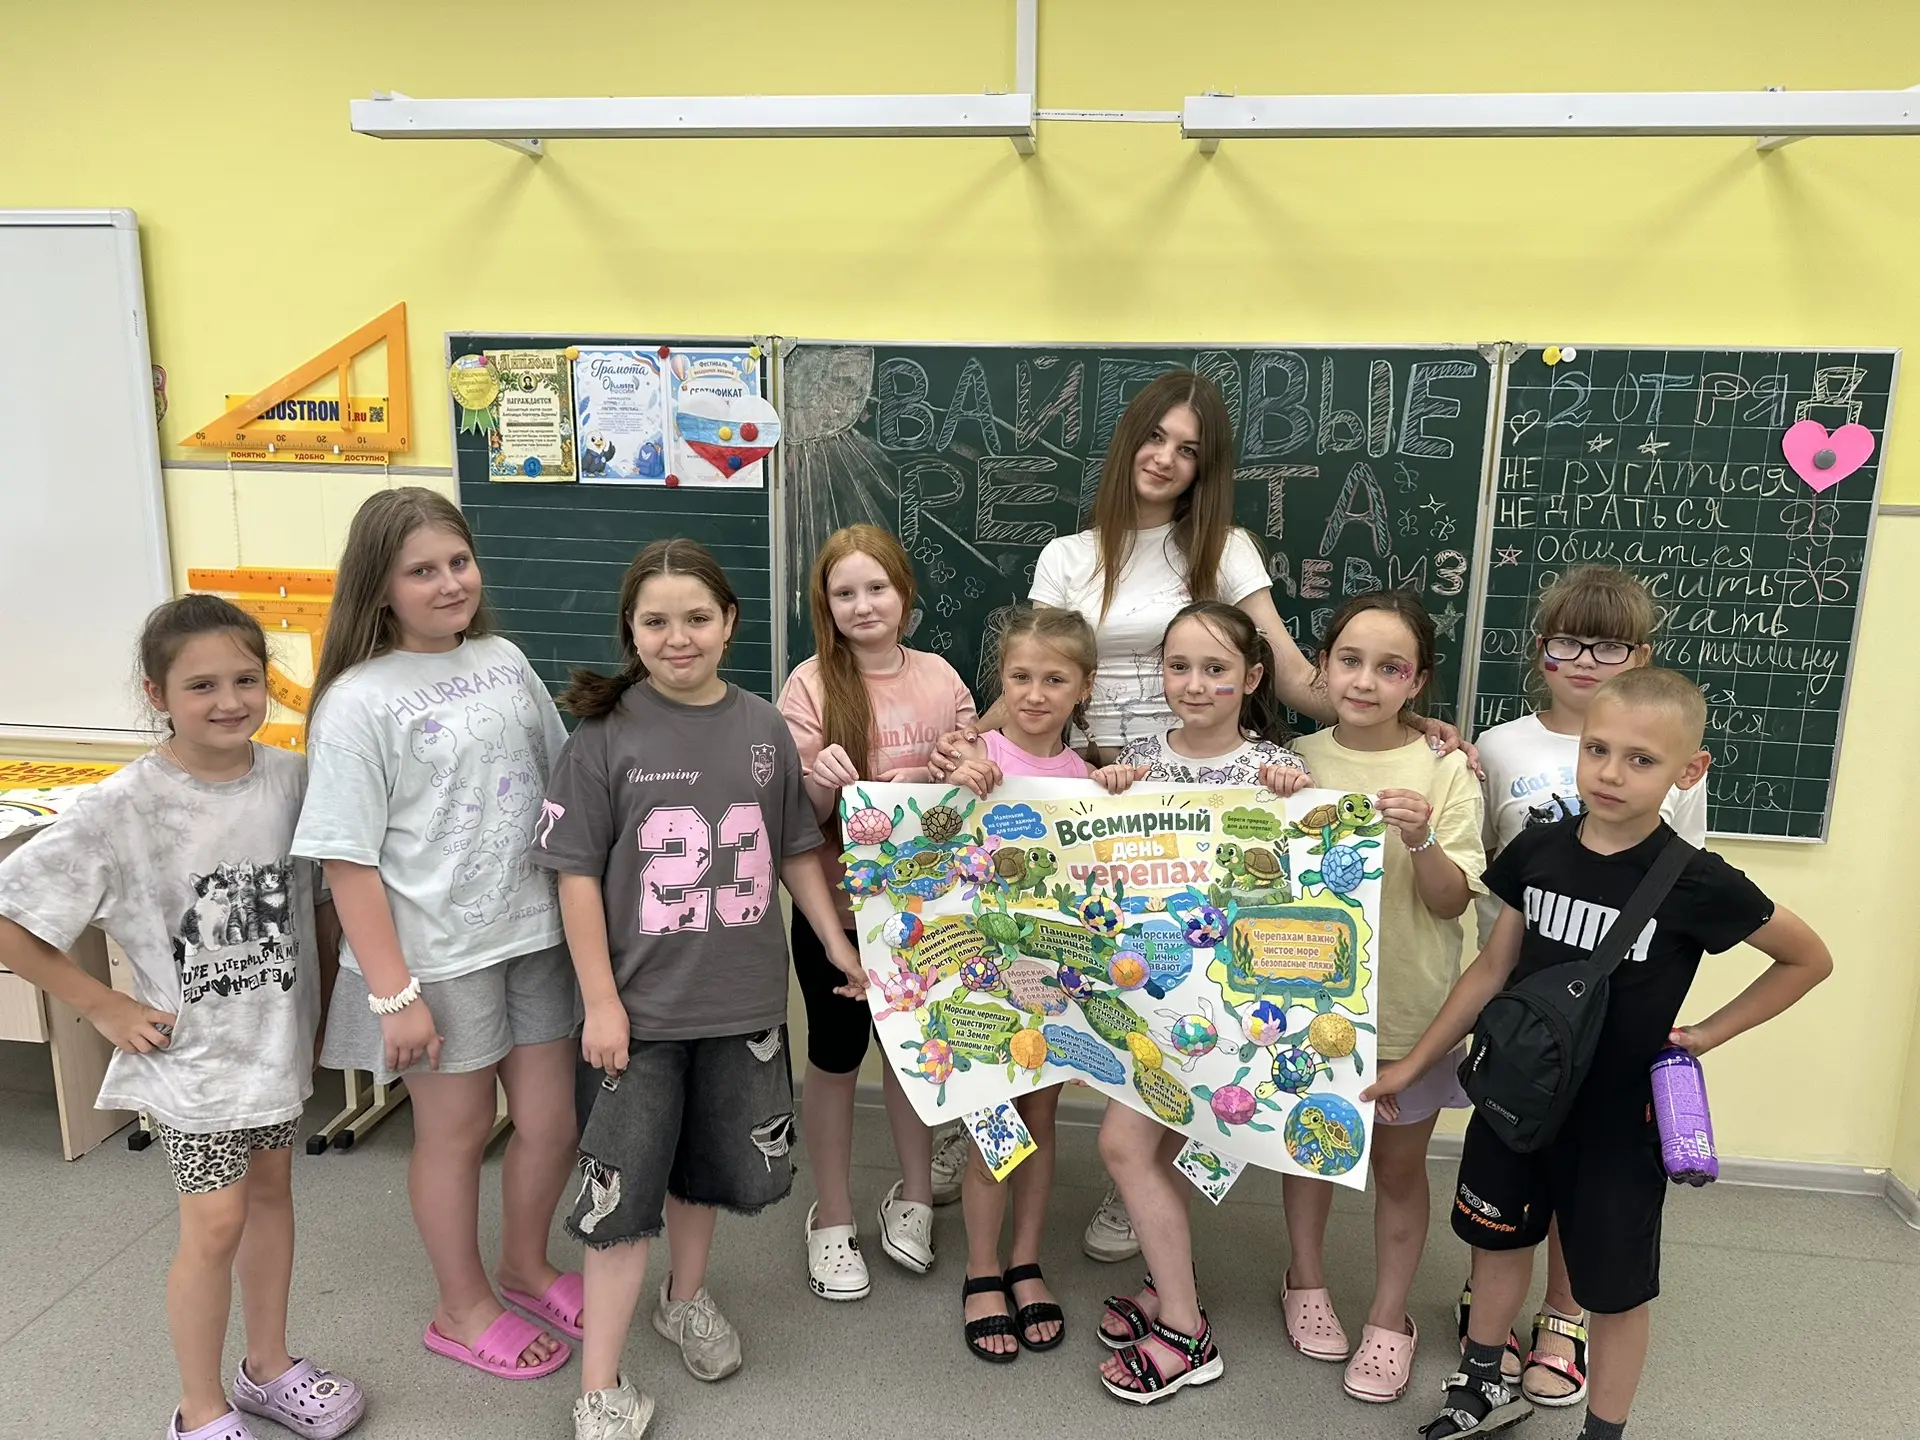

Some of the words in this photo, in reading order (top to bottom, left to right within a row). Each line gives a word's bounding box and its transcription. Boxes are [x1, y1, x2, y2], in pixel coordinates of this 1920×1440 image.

[591, 359, 649, 379] Грамота
[1545, 371, 1592, 428] 2
[294, 453, 325, 461] УДОБНО
[344, 454, 385, 462] ДОСТУПНО
[1501, 457, 1542, 490] НЕ
[1501, 496, 1536, 529] НЕ
[626, 768, 703, 785] Charming
[993, 812, 1024, 821] Маленькие
[1055, 808, 1211, 847] Всемирный
[442, 838, 473, 857] SLEEP
[1112, 840, 1165, 860] день
[637, 802, 773, 935] 23
[1071, 859, 1211, 893] черепах
[509, 900, 556, 922] FRIENDS
[920, 922, 959, 944] Передние
[1522, 886, 1658, 962] PUMA
[947, 929, 979, 941] помогают
[1039, 925, 1091, 942] Панцирь
[1132, 931, 1182, 941] Морские
[1253, 930, 1304, 943] Черепахам
[1306, 932, 1336, 944] важно
[957, 945, 981, 958] плыть
[1040, 935, 1092, 953] защищае
[1263, 945, 1294, 956] чистое
[1296, 947, 1319, 958] море
[1259, 956, 1307, 969] безопасные
[1308, 960, 1334, 971] пляжи
[1007, 969, 1048, 978] Морские
[943, 1002, 976, 1016] Морские
[976, 1011, 1011, 1023] черепахи
[951, 1017, 997, 1031] существуют
[955, 1029, 965, 1037] на
[966, 1029, 991, 1041] Земле
[1060, 1030, 1100, 1050] Некоторые
[982, 1044, 995, 1052] лет
[1144, 1082, 1182, 1109] прочный
[1154, 1081, 1176, 1098] есть
[1145, 1089, 1181, 1115] панцирь
[1160, 1327, 1179, 1341] YOUNG
